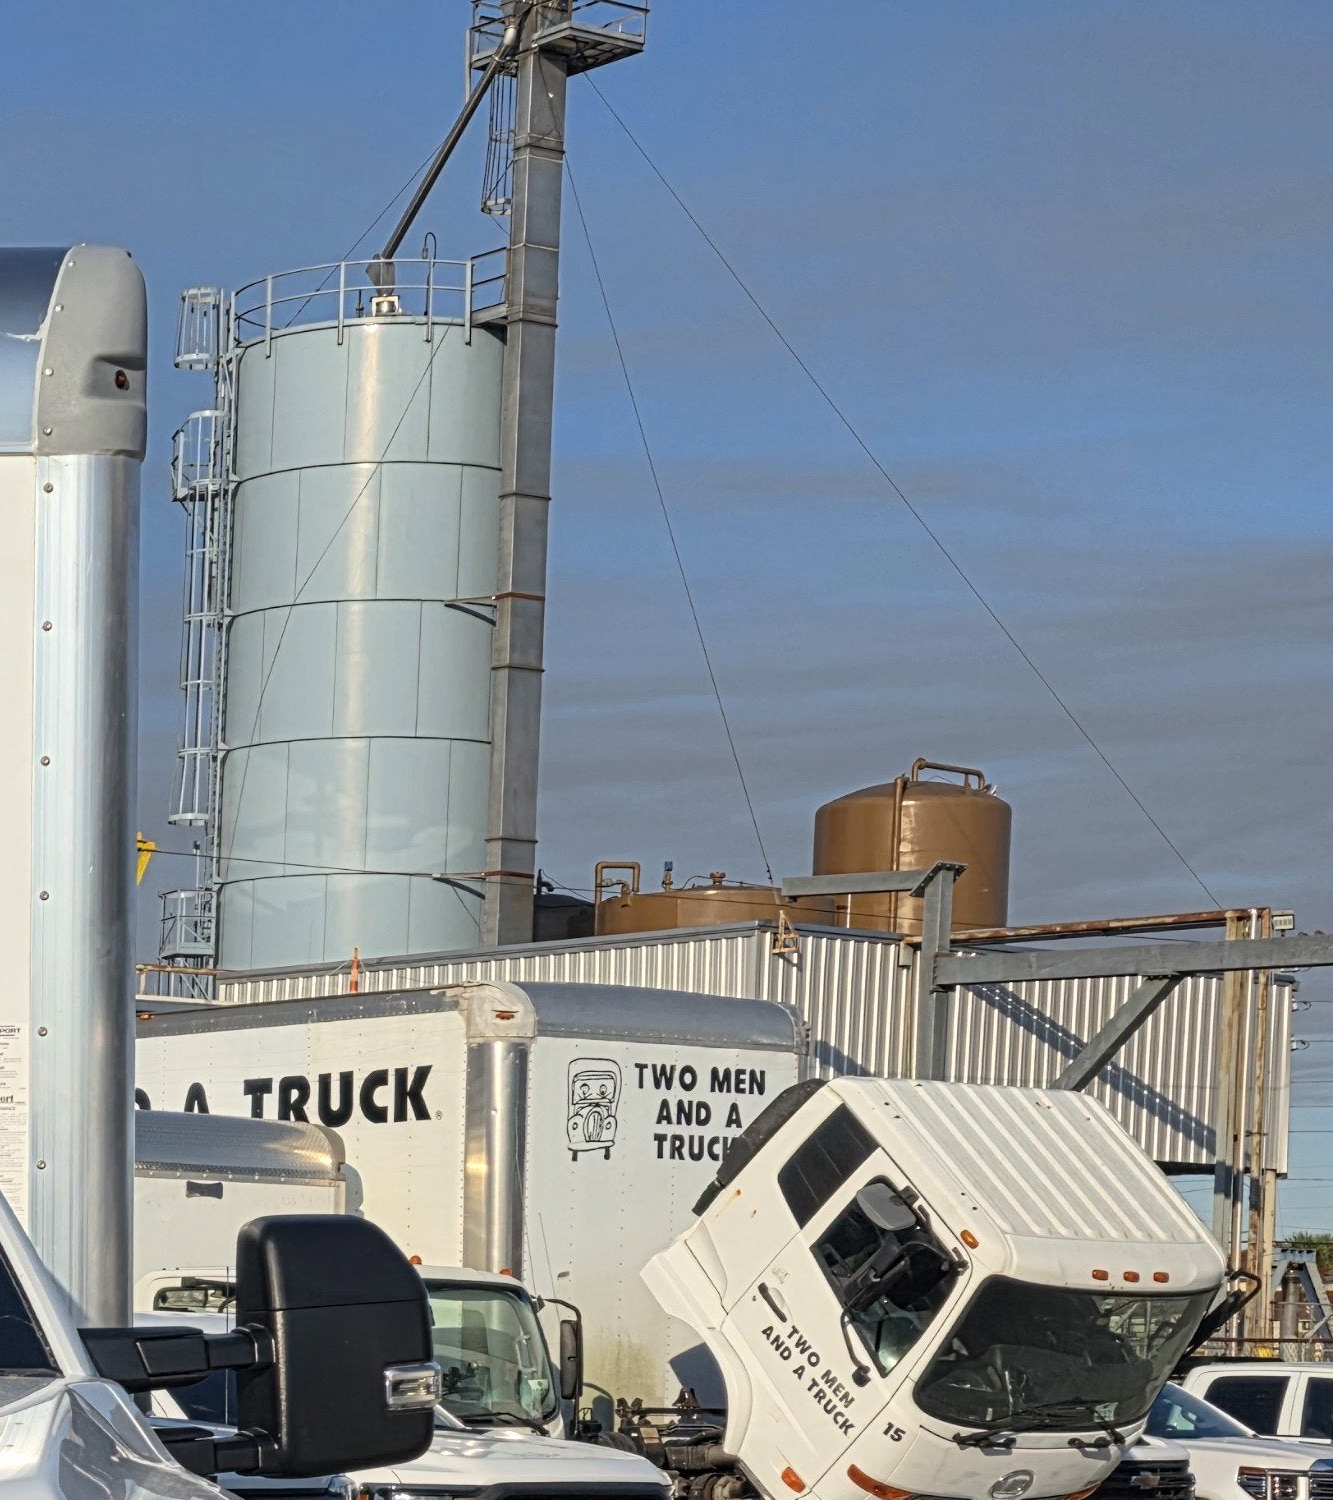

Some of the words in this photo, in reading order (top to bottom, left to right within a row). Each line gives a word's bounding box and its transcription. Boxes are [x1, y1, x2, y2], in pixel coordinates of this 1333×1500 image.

[184, 1082, 209, 1114] A
[243, 1064, 433, 1128] TRUCK
[635, 1063, 698, 1091] TWO
[710, 1066, 766, 1095] MEN
[655, 1098, 712, 1126] AND
[725, 1102, 742, 1128] A
[761, 1326, 792, 1361] AND
[792, 1365, 806, 1380] A
[806, 1378, 856, 1436] TRUCK
[787, 1325, 821, 1367] TWO
[821, 1369, 855, 1408] MEN
[882, 1422, 907, 1442] 15
